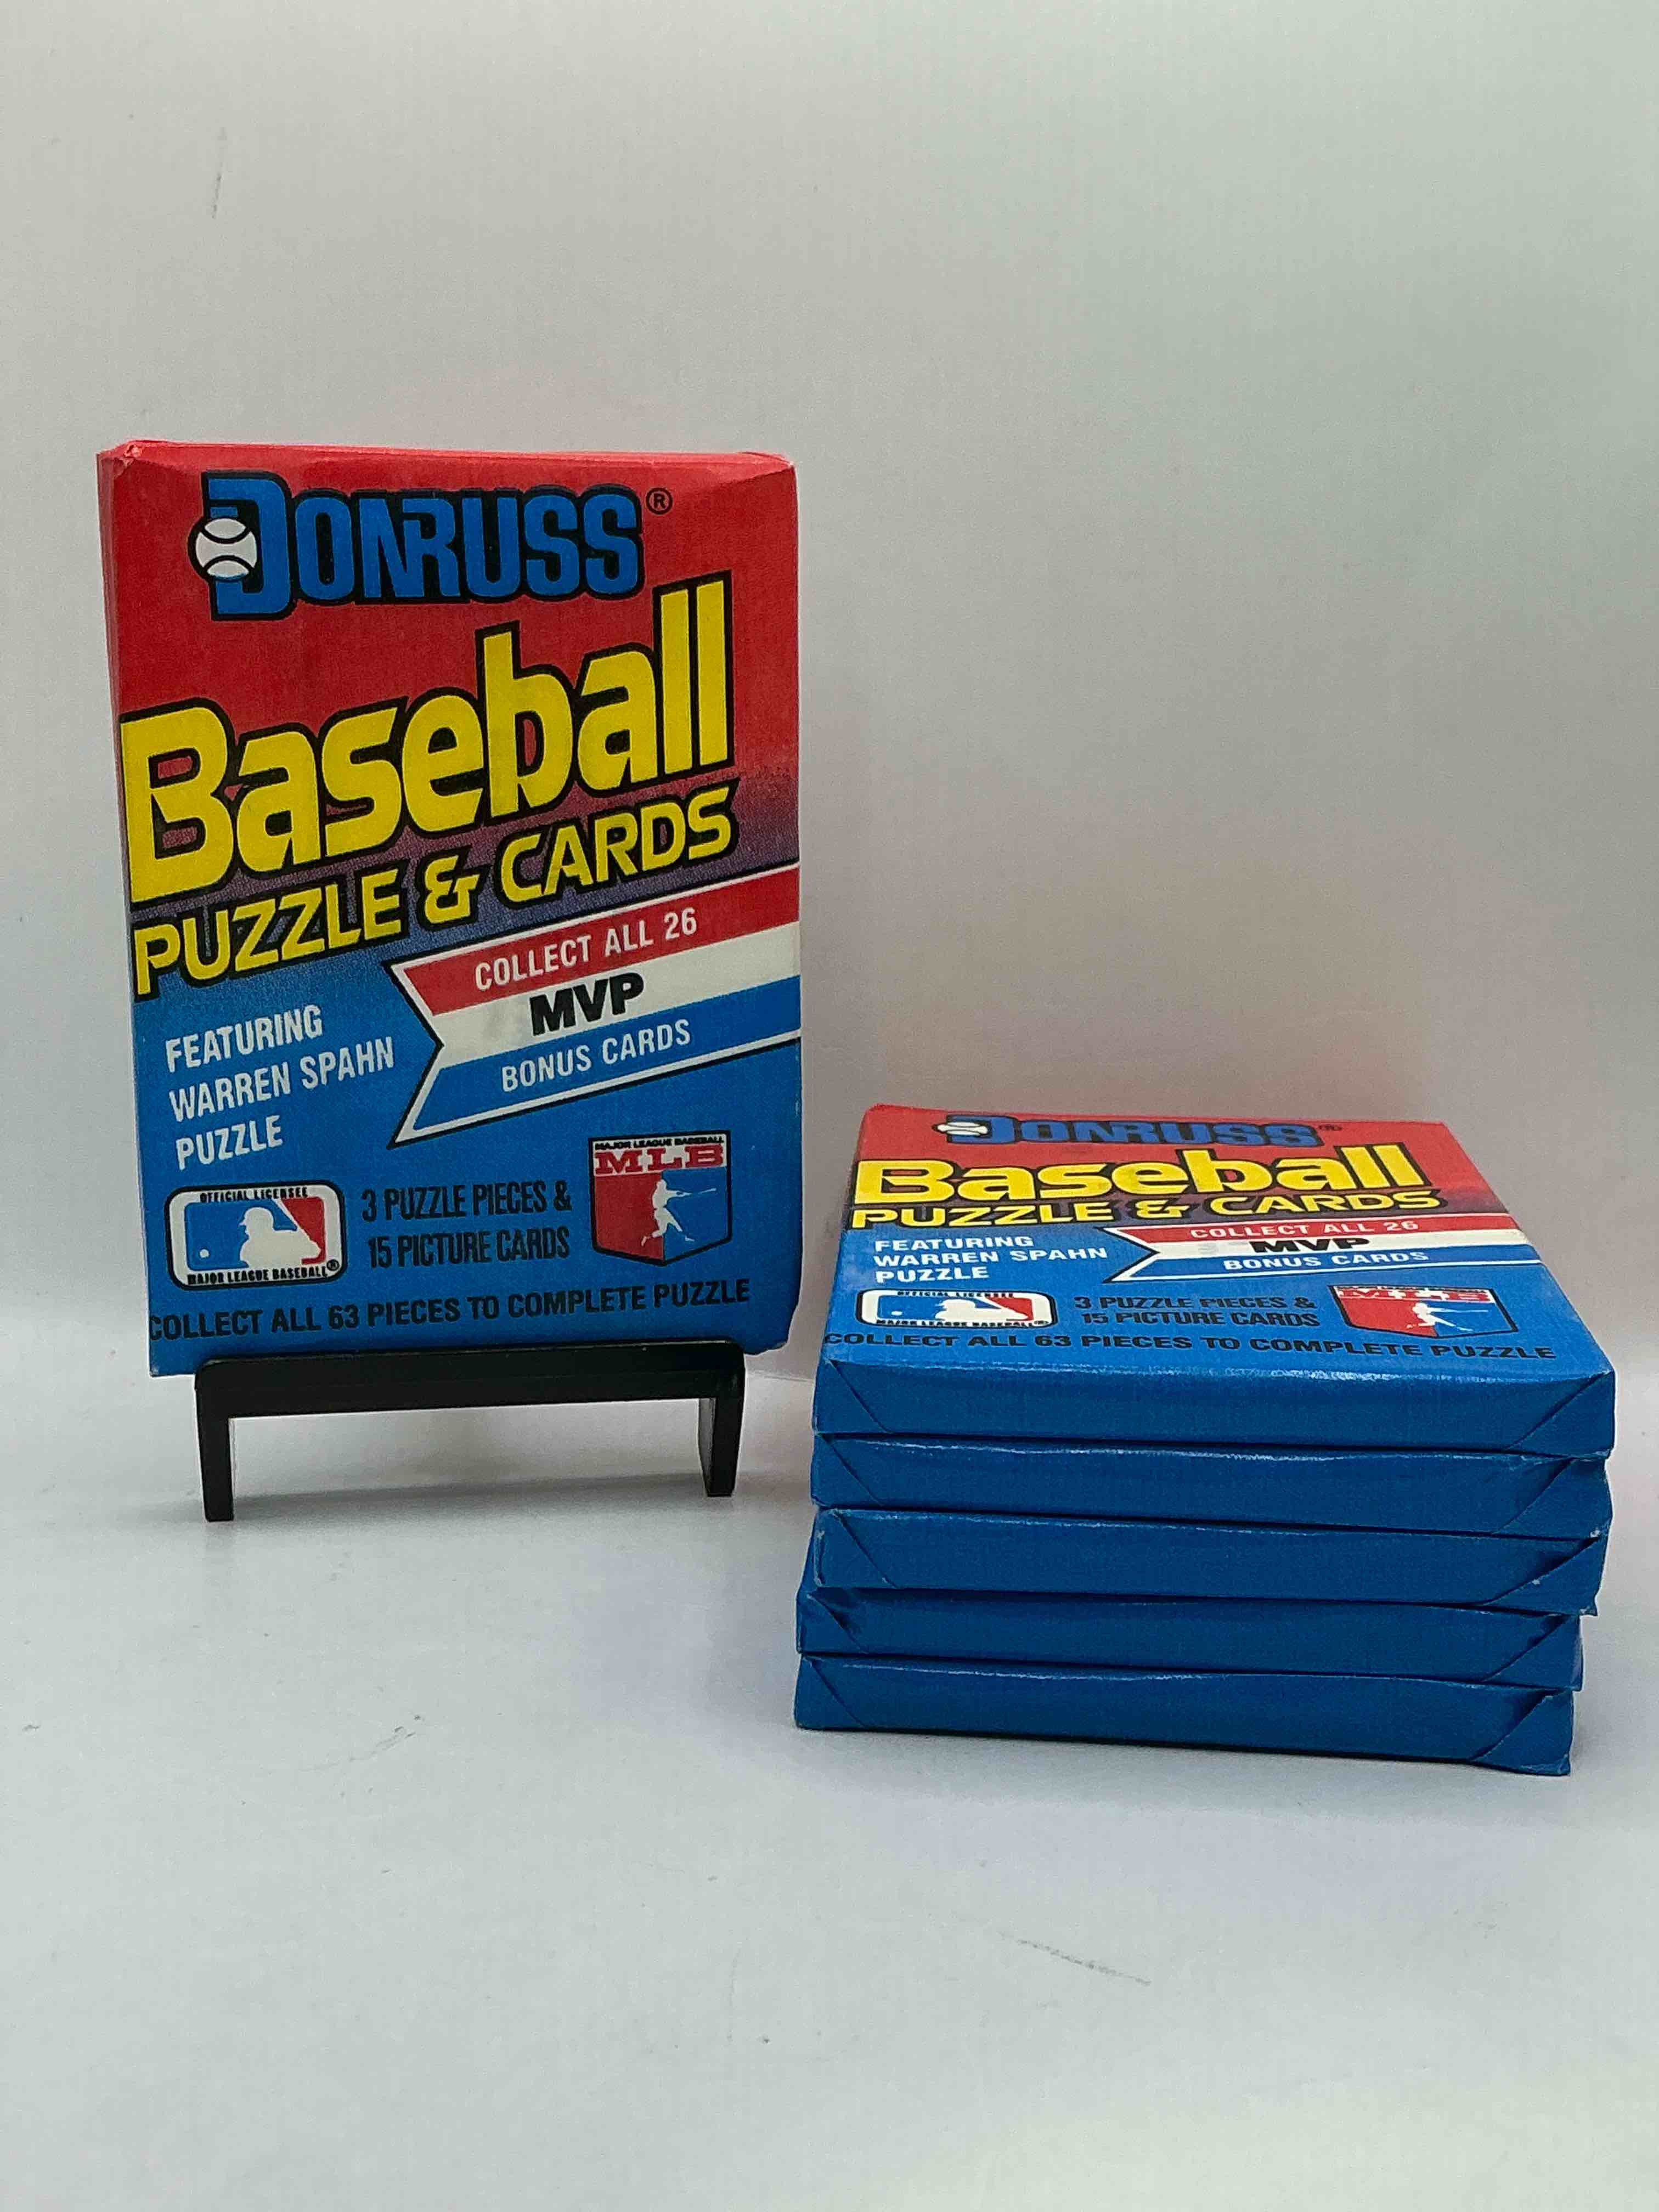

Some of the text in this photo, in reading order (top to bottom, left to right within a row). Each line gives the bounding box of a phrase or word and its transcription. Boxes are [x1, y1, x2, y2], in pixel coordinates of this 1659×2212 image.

[119, 569, 733, 908] Baseball
[132, 780, 738, 1001] PUZZLE & CARDS
[475, 907, 697, 990] COLLECT ALL 26
[529, 972, 644, 1036] MVP
[165, 1005, 323, 1072] FEATURING
[502, 1019, 690, 1092] BONUS CARDS
[169, 1037, 394, 1122] WARREN SPAHN
[176, 1115, 283, 1170] PUZZLE
[595, 1143, 724, 1174] MLB
[851, 1142, 1431, 1206] Baseball
[200, 1187, 308, 1203] OFFICIAL LICENSEE
[360, 1180, 572, 1222] 3 PUZZLE PIECES &
[850, 1190, 1445, 1229] PUZZLE & CARDS
[368, 1226, 570, 1268] 15 PICTURE CARDS
[875, 1236, 1034, 1252] FEATURING
[1190, 1221, 1418, 1238] COLLECT ALL 26
[1249, 1238, 1370, 1252] MVP
[187, 1266, 328, 1285] MAJOR LEAGUE BASEBALL
[873, 1248, 1107, 1267] WARREN SPAHN
[876, 1267, 990, 1283] PUZZLE
[1223, 1251, 1429, 1270] BONUS CARDS
[149, 1278, 751, 1340] COLLECT ALL 63 PIECES TO COMPLETE PUZZLE
[1074, 1296, 1317, 1309] 3 PUZZLE PIECES &
[1082, 1312, 1320, 1327] 15 PICTURE CARDS
[825, 1333, 1556, 1359] COLLECT ALL 63 PIECES TO COMPLETE PUZZLE
